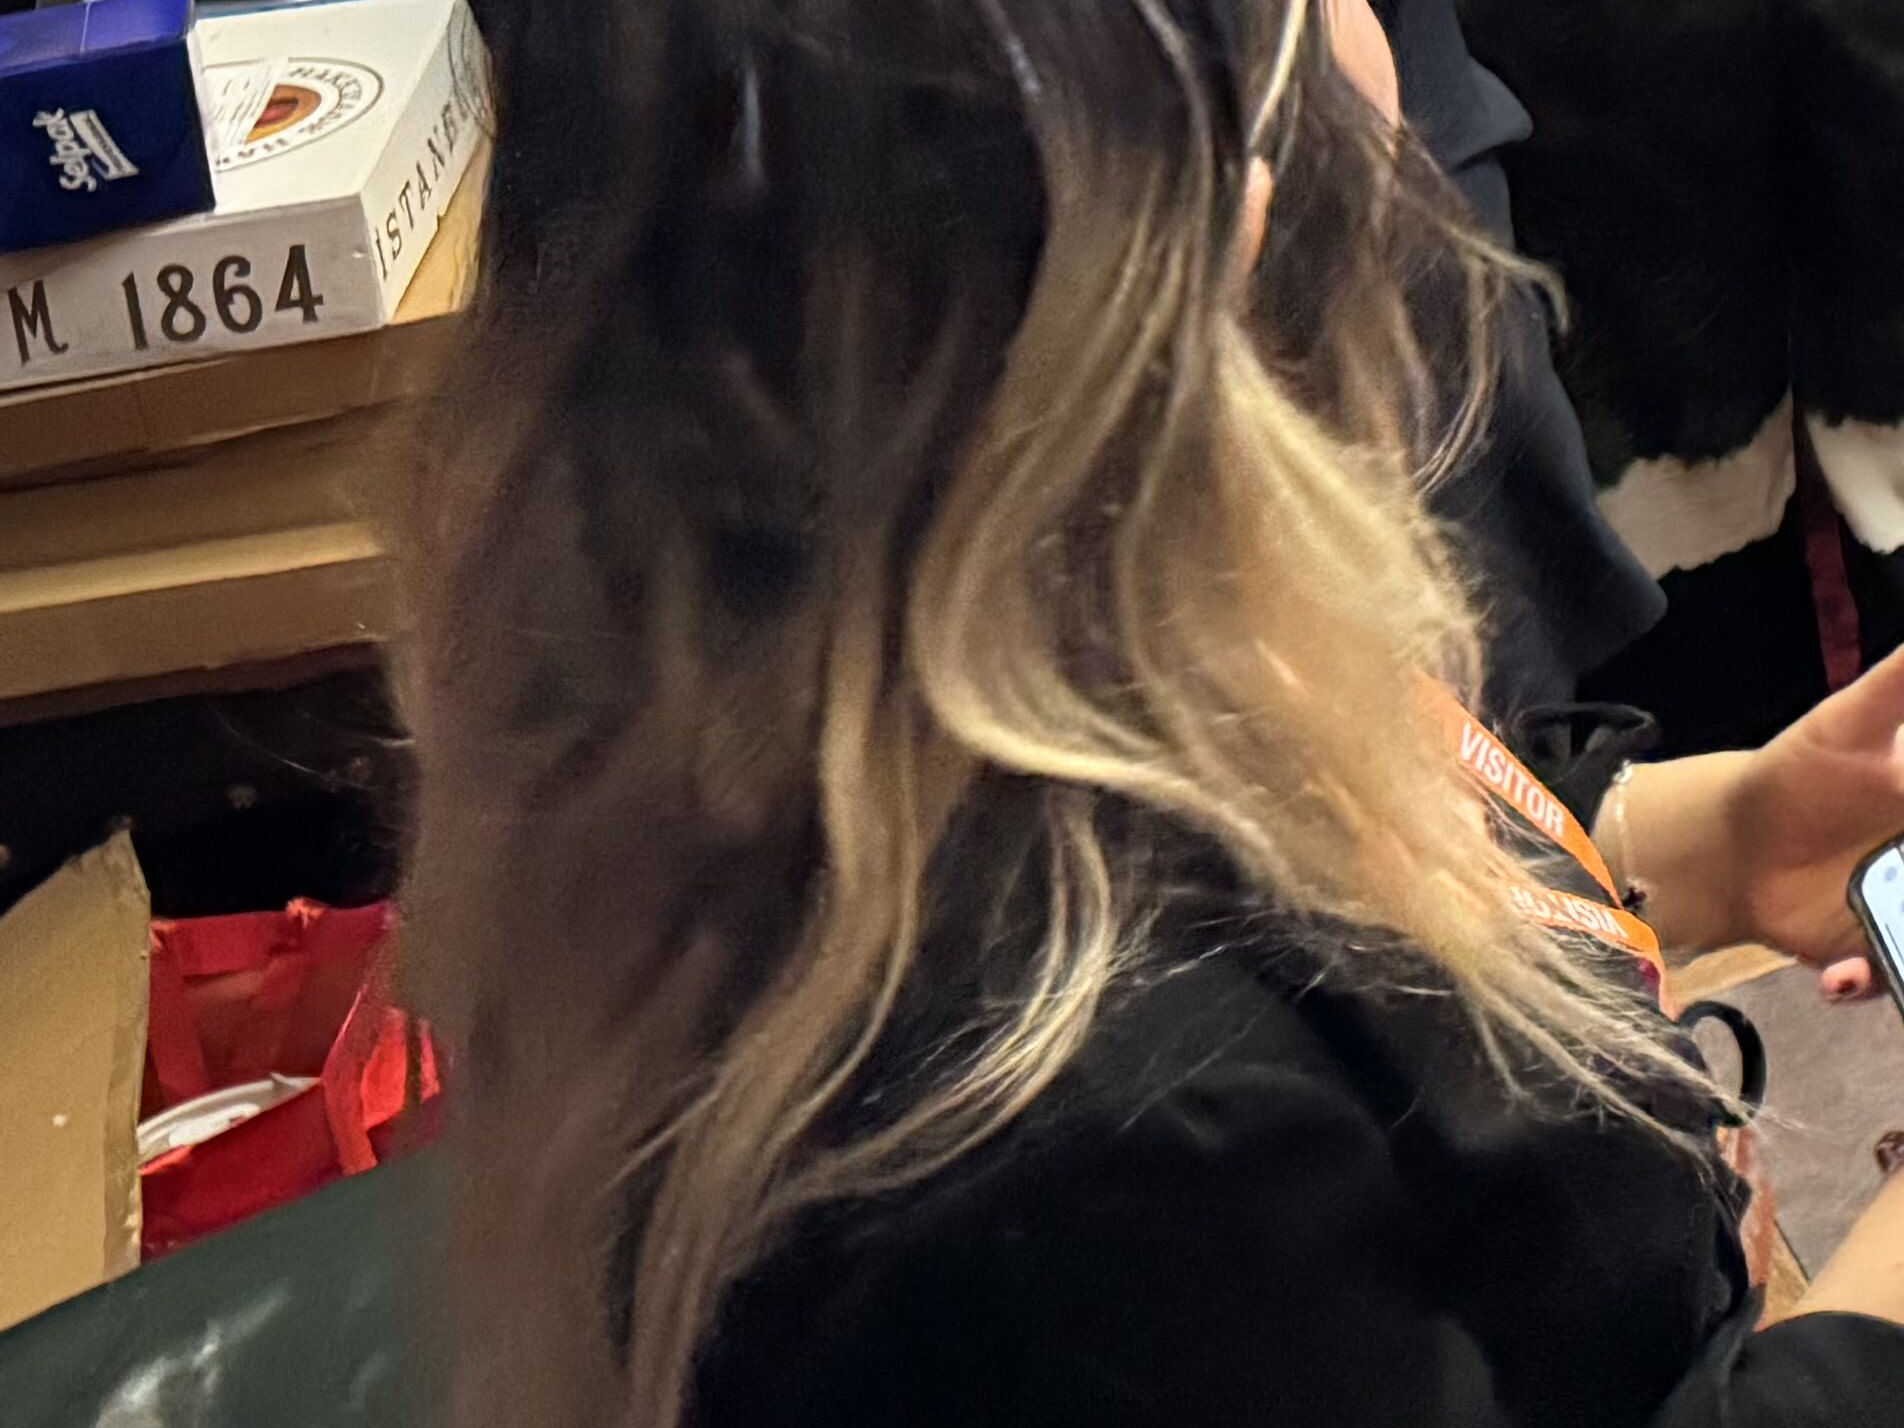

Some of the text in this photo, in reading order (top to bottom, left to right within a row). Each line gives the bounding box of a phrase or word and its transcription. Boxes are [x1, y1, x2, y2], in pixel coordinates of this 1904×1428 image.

[32, 107, 98, 193] Selpak
[8, 244, 324, 367] M 1864
[1459, 721, 1565, 838] VISITOR
